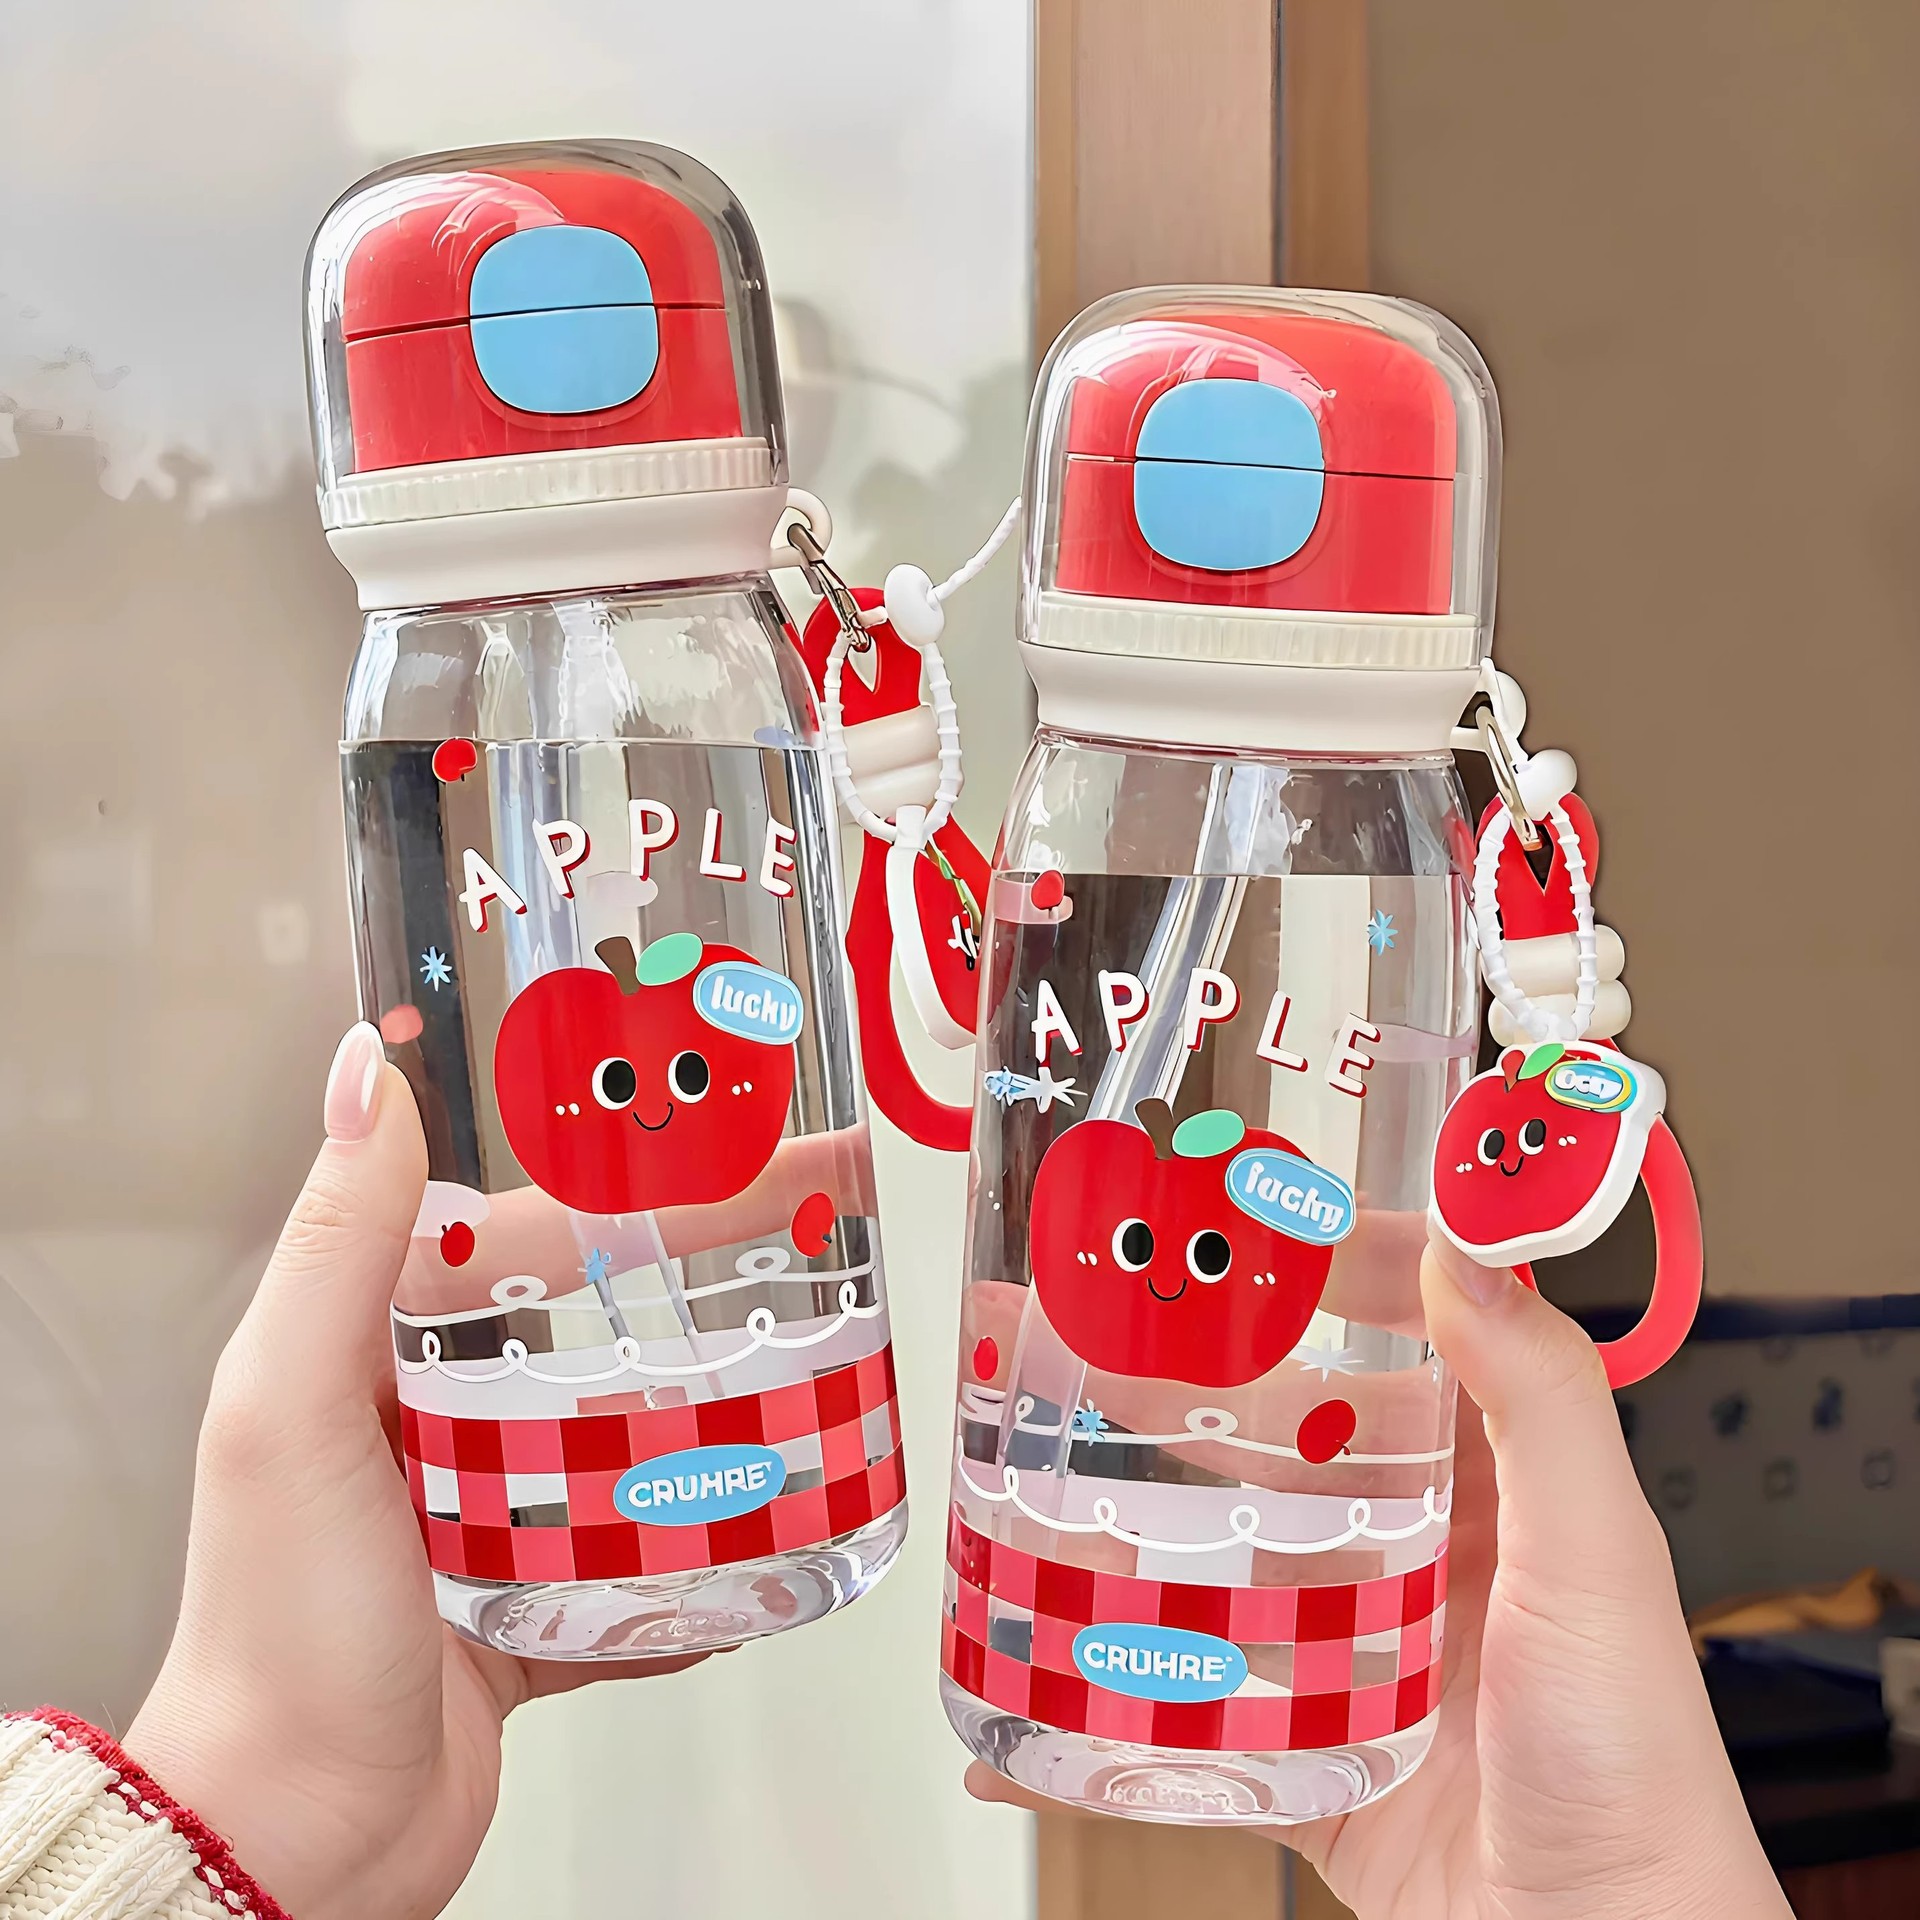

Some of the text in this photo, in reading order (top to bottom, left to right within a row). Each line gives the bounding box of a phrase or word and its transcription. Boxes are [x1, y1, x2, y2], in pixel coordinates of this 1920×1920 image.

[458, 799, 797, 932] APPLE
[711, 975, 797, 1032] lucky
[1031, 967, 1381, 1098] APPLE
